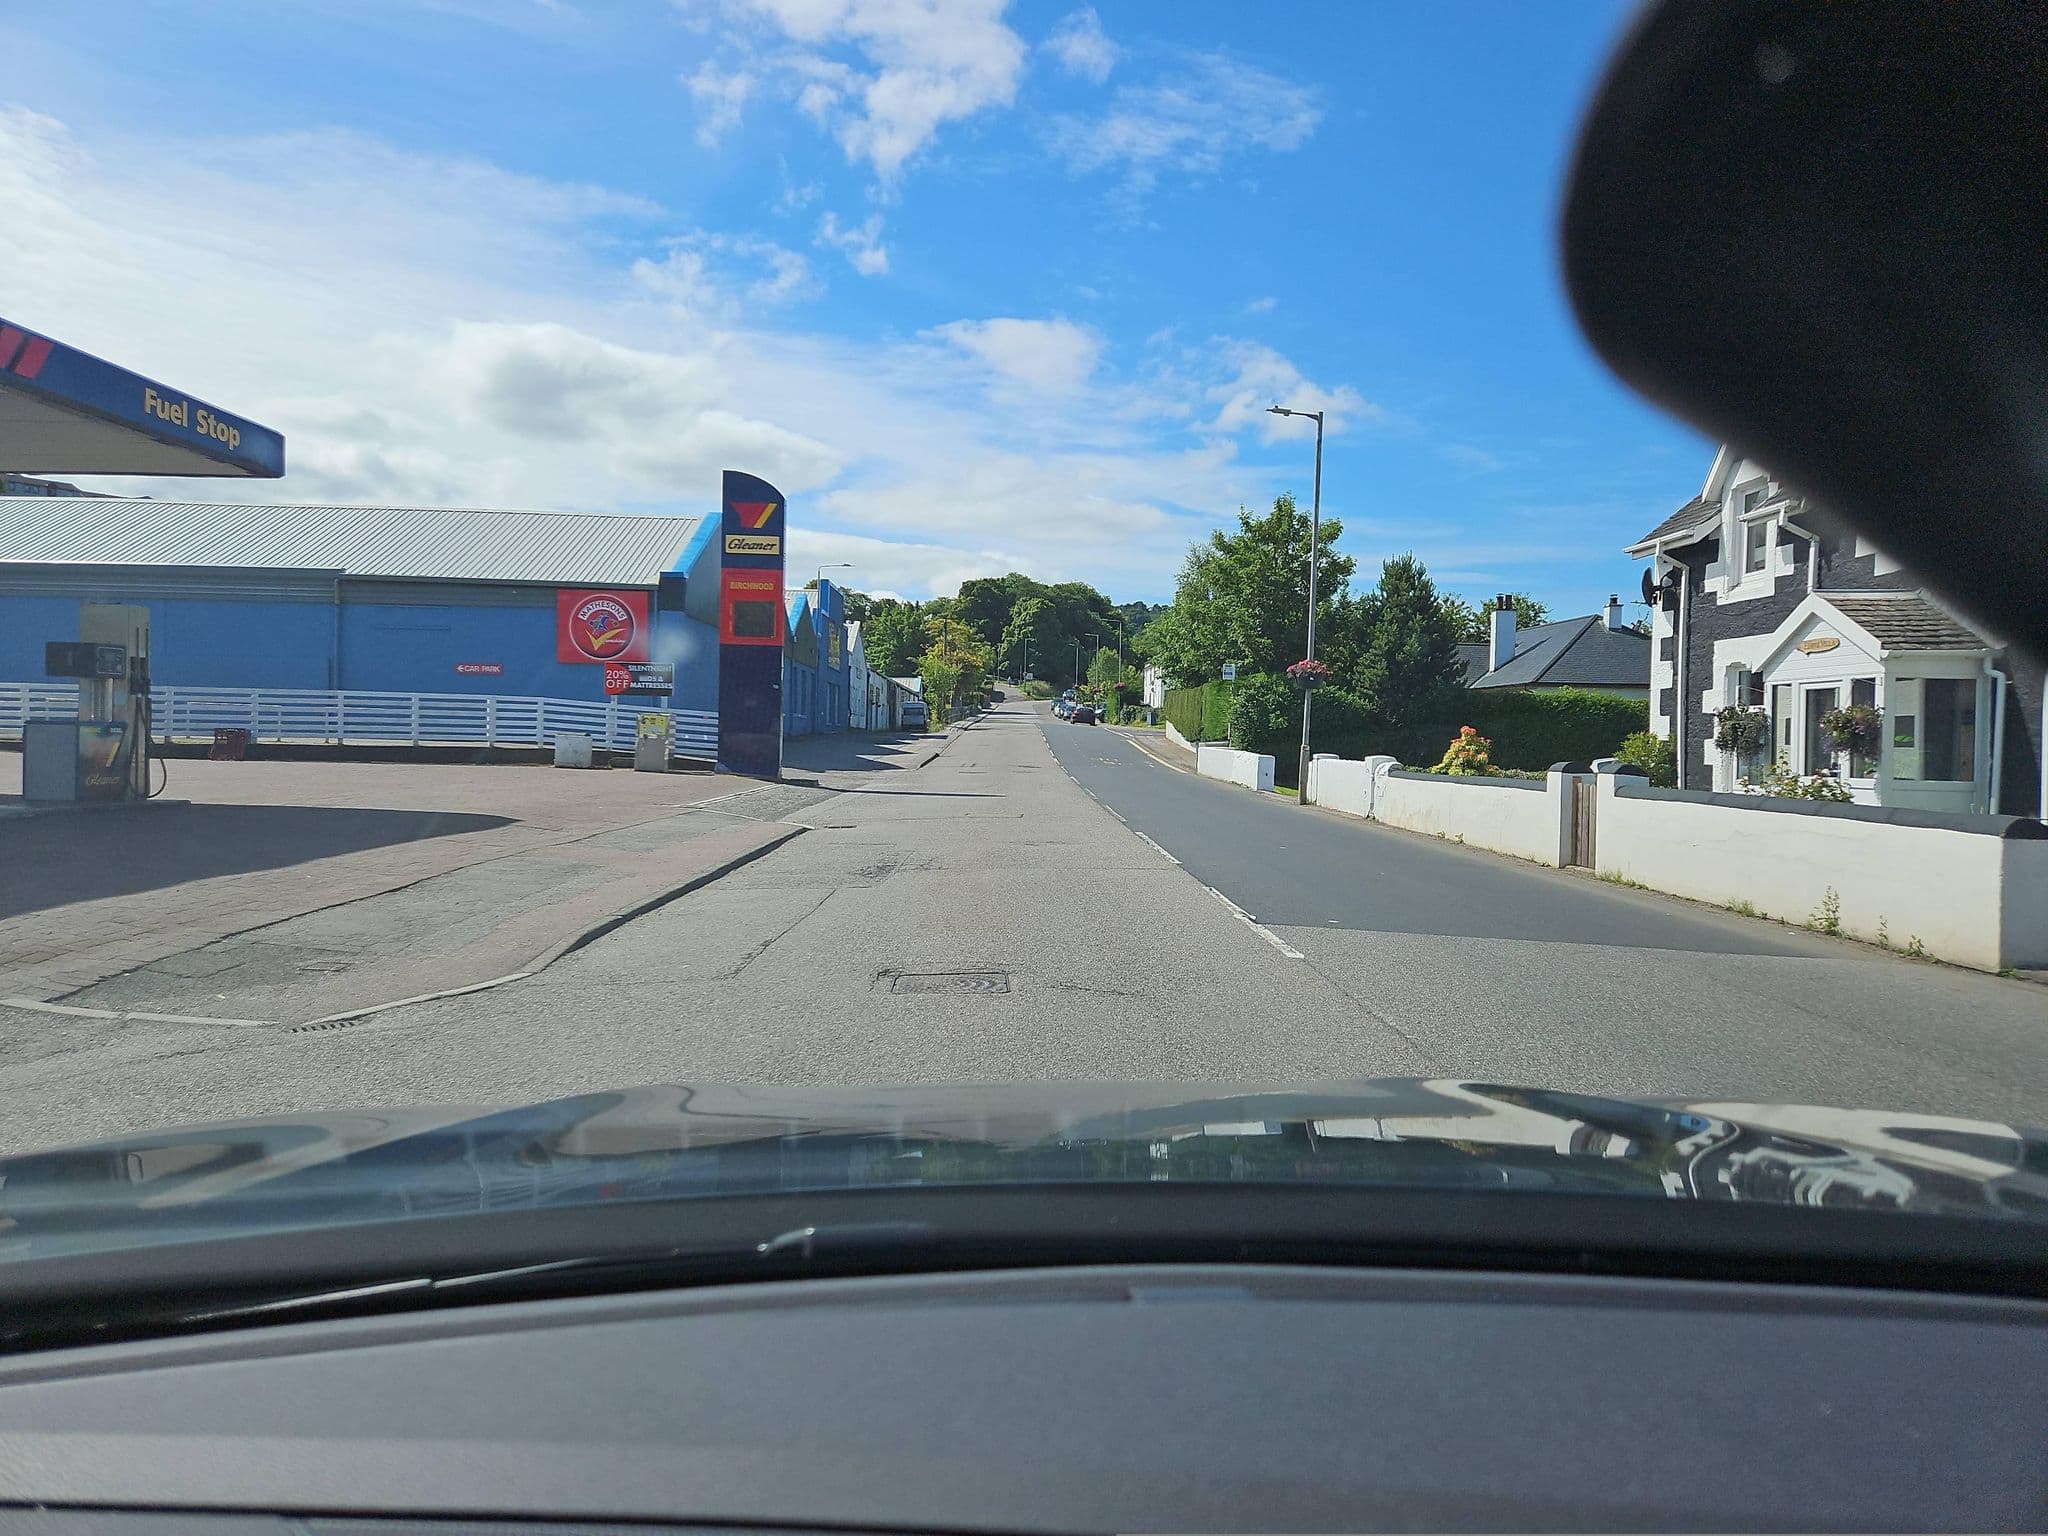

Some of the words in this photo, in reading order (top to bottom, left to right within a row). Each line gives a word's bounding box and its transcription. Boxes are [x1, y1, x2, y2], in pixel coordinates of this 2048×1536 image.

[144, 387, 188, 428] Fuel
[196, 409, 240, 451] Stop
[727, 538, 777, 551] Gleaner
[729, 581, 775, 591] BIRCHWOOD
[580, 601, 626, 619] MATHESONS
[606, 670, 629, 679] 20%
[606, 679, 629, 689] OFF
